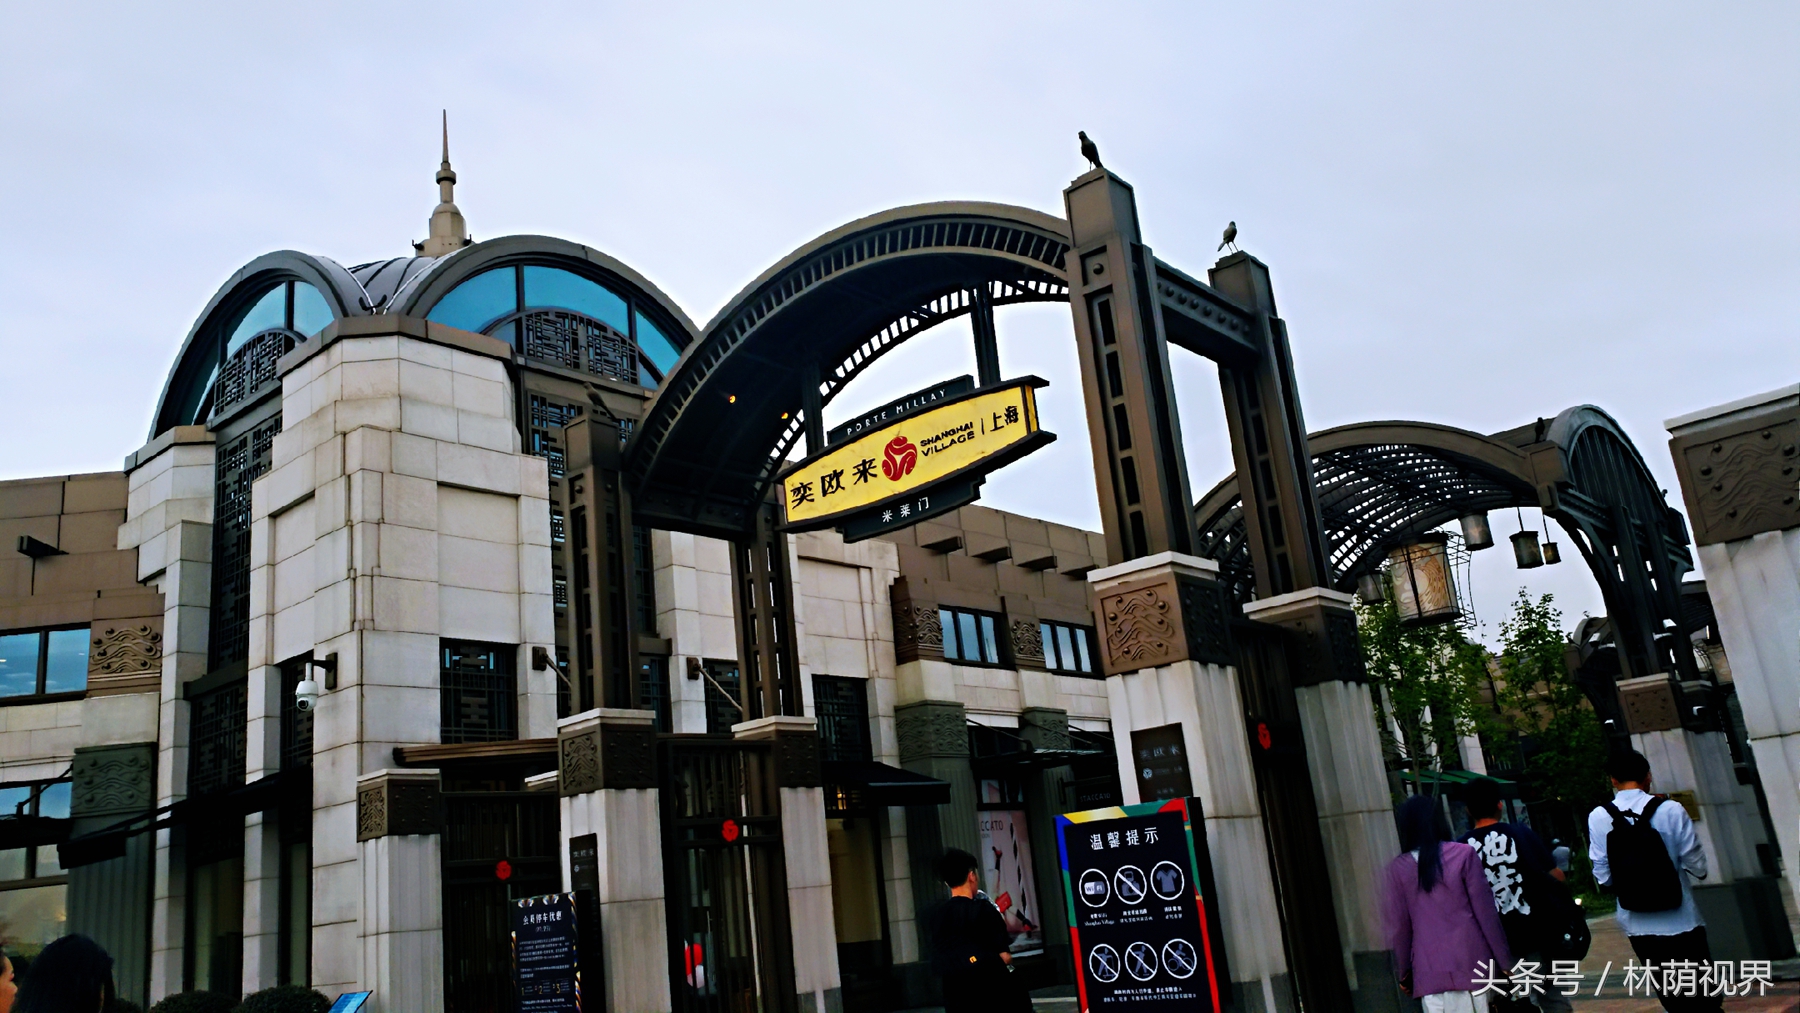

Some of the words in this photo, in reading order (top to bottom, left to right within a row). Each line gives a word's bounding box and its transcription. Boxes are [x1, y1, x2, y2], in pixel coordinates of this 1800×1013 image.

[846, 411, 887, 436] PORTE
[895, 388, 946, 414] MILLAY
[989, 405, 1019, 432] 上海
[920, 421, 974, 447] SHANGHAI
[921, 430, 975, 457] VILLAGE
[790, 457, 878, 510] 奕欧来
[881, 496, 930, 523] 米莱门
[1089, 826, 1159, 850] 温馨提示
